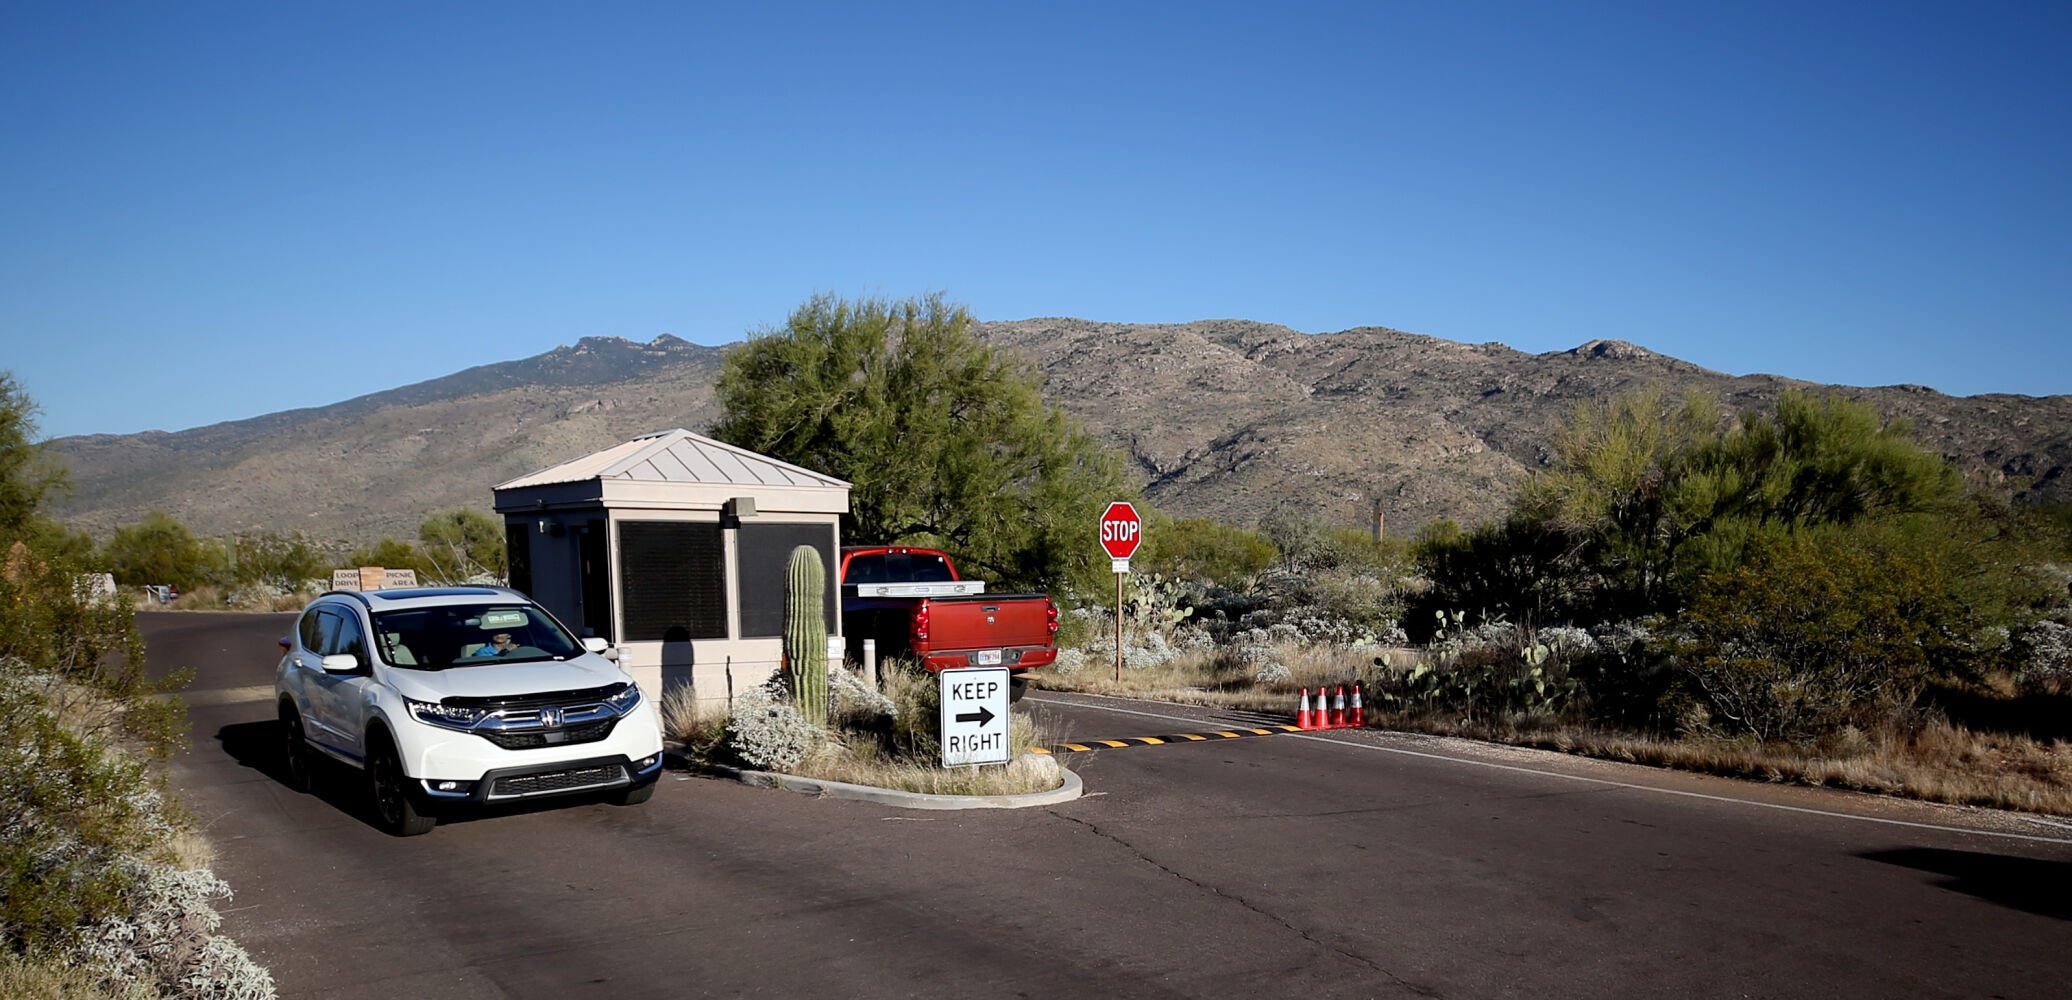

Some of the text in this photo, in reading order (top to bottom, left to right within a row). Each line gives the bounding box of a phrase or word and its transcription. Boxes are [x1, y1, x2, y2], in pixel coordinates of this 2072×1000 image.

[1103, 520, 1138, 541] STOP
[952, 682, 998, 701] KEEP
[950, 733, 1002, 753] RIGHT
